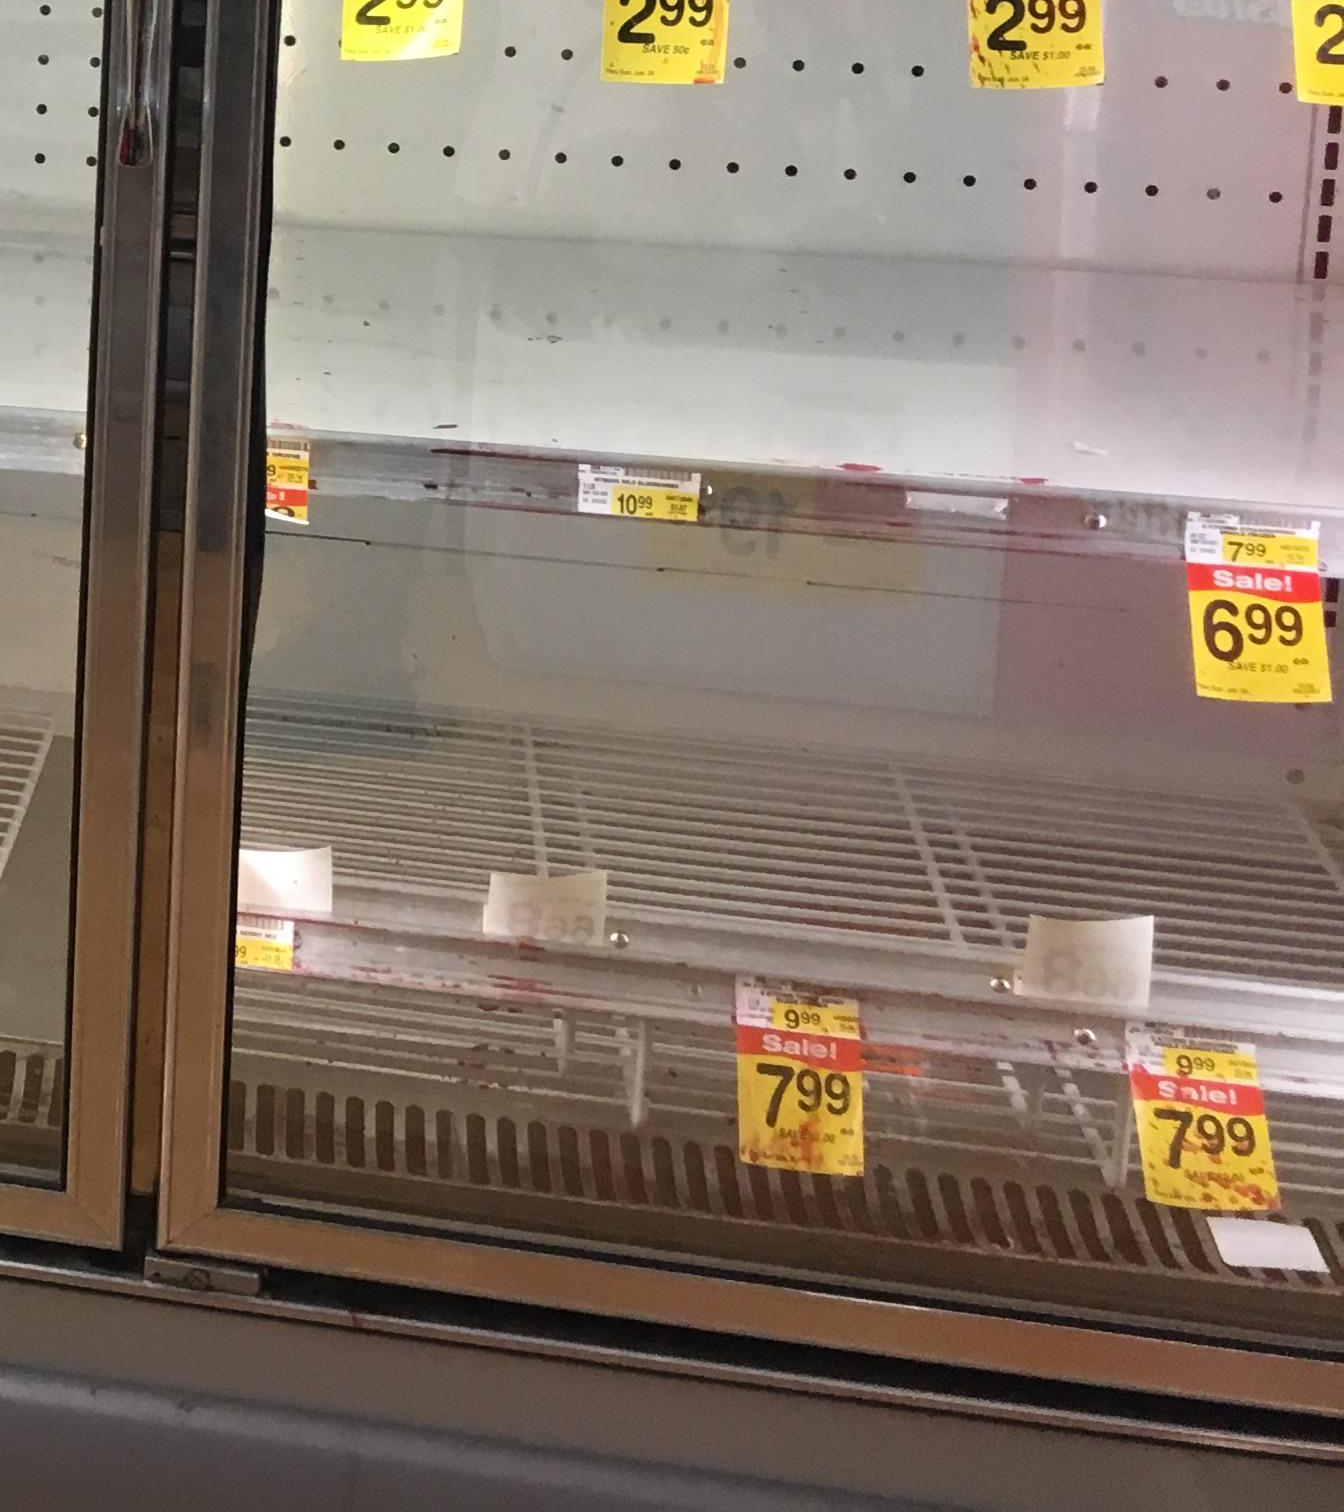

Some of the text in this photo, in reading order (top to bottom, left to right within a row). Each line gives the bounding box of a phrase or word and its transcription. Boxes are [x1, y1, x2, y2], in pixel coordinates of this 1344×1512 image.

[642, 43, 670, 54] SAVE
[1009, 50, 1071, 60] SAVE $1.00
[616, 493, 653, 515] 1099
[1227, 541, 1266, 562] 799
[1212, 569, 1292, 593] Sale!
[1203, 599, 1303, 663] 699
[783, 1008, 820, 1029] 999
[762, 1033, 837, 1060] Sale!
[1176, 1054, 1216, 1076] 999
[756, 1062, 850, 1128] 799
[1158, 1080, 1237, 1105] Sale!
[1153, 1107, 1256, 1169] 799
